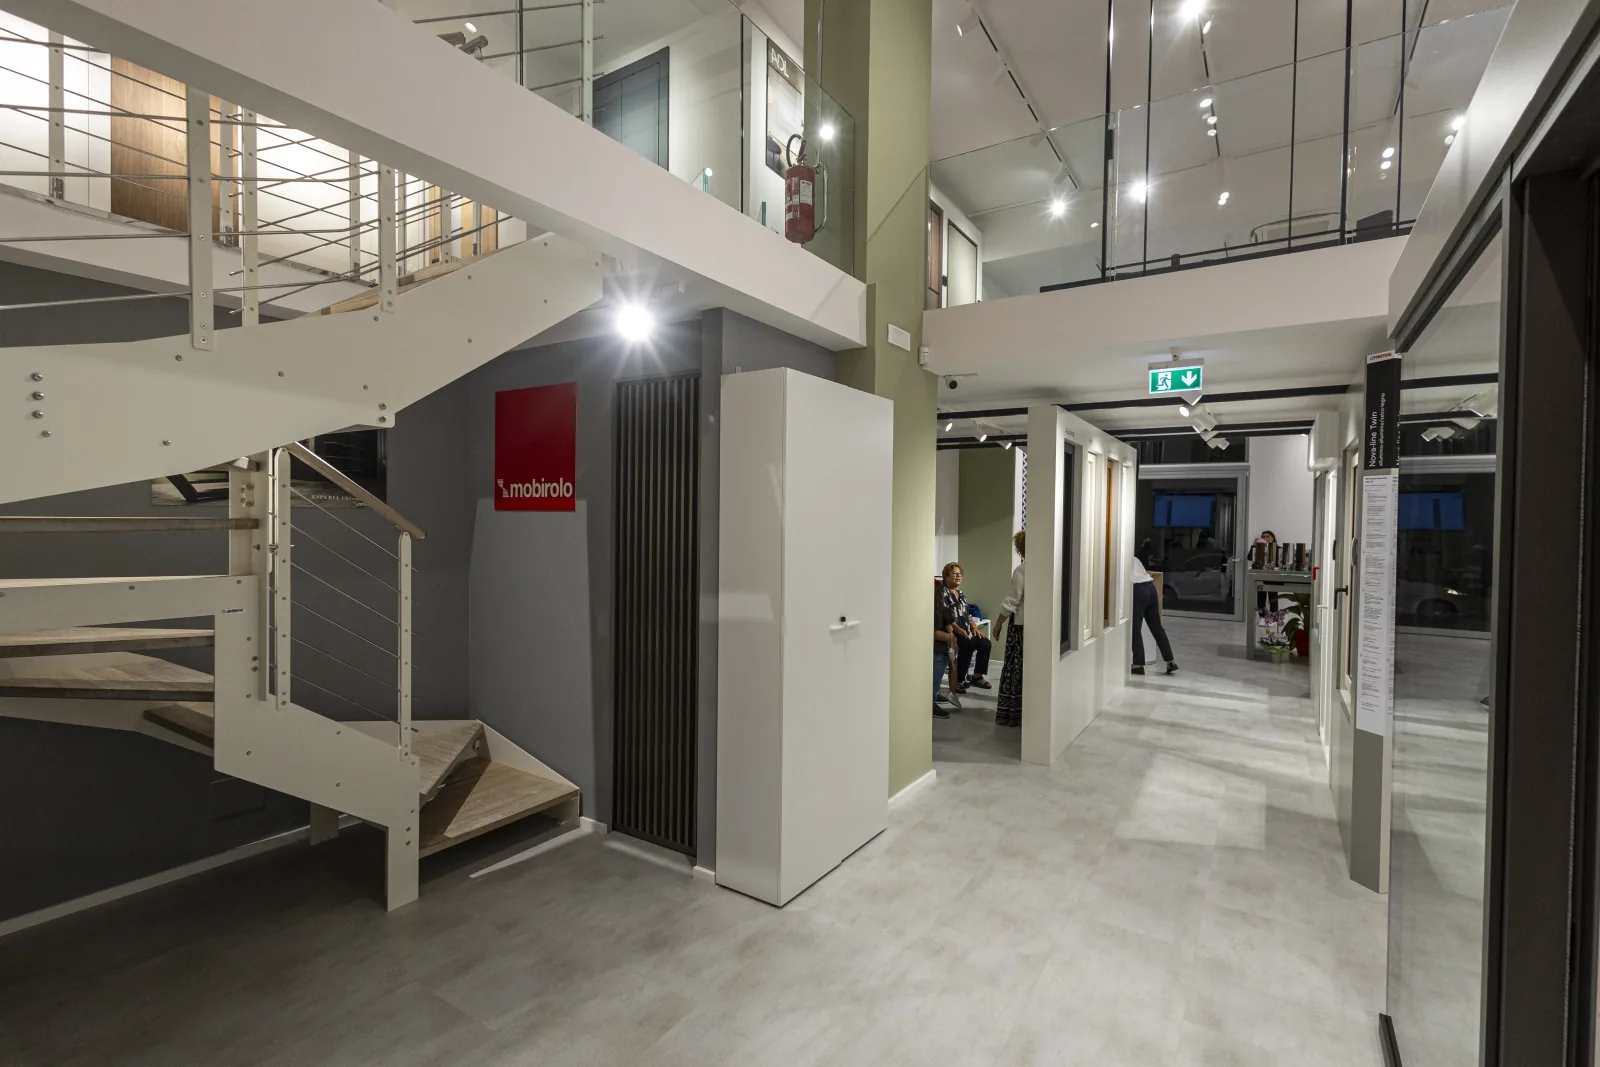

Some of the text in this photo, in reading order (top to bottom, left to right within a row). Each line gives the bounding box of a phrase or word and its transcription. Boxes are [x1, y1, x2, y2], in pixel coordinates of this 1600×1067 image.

[771, 47, 790, 78] ADL
[1369, 411, 1378, 467] Nova-line Twin
[510, 477, 573, 498] mobirolo
